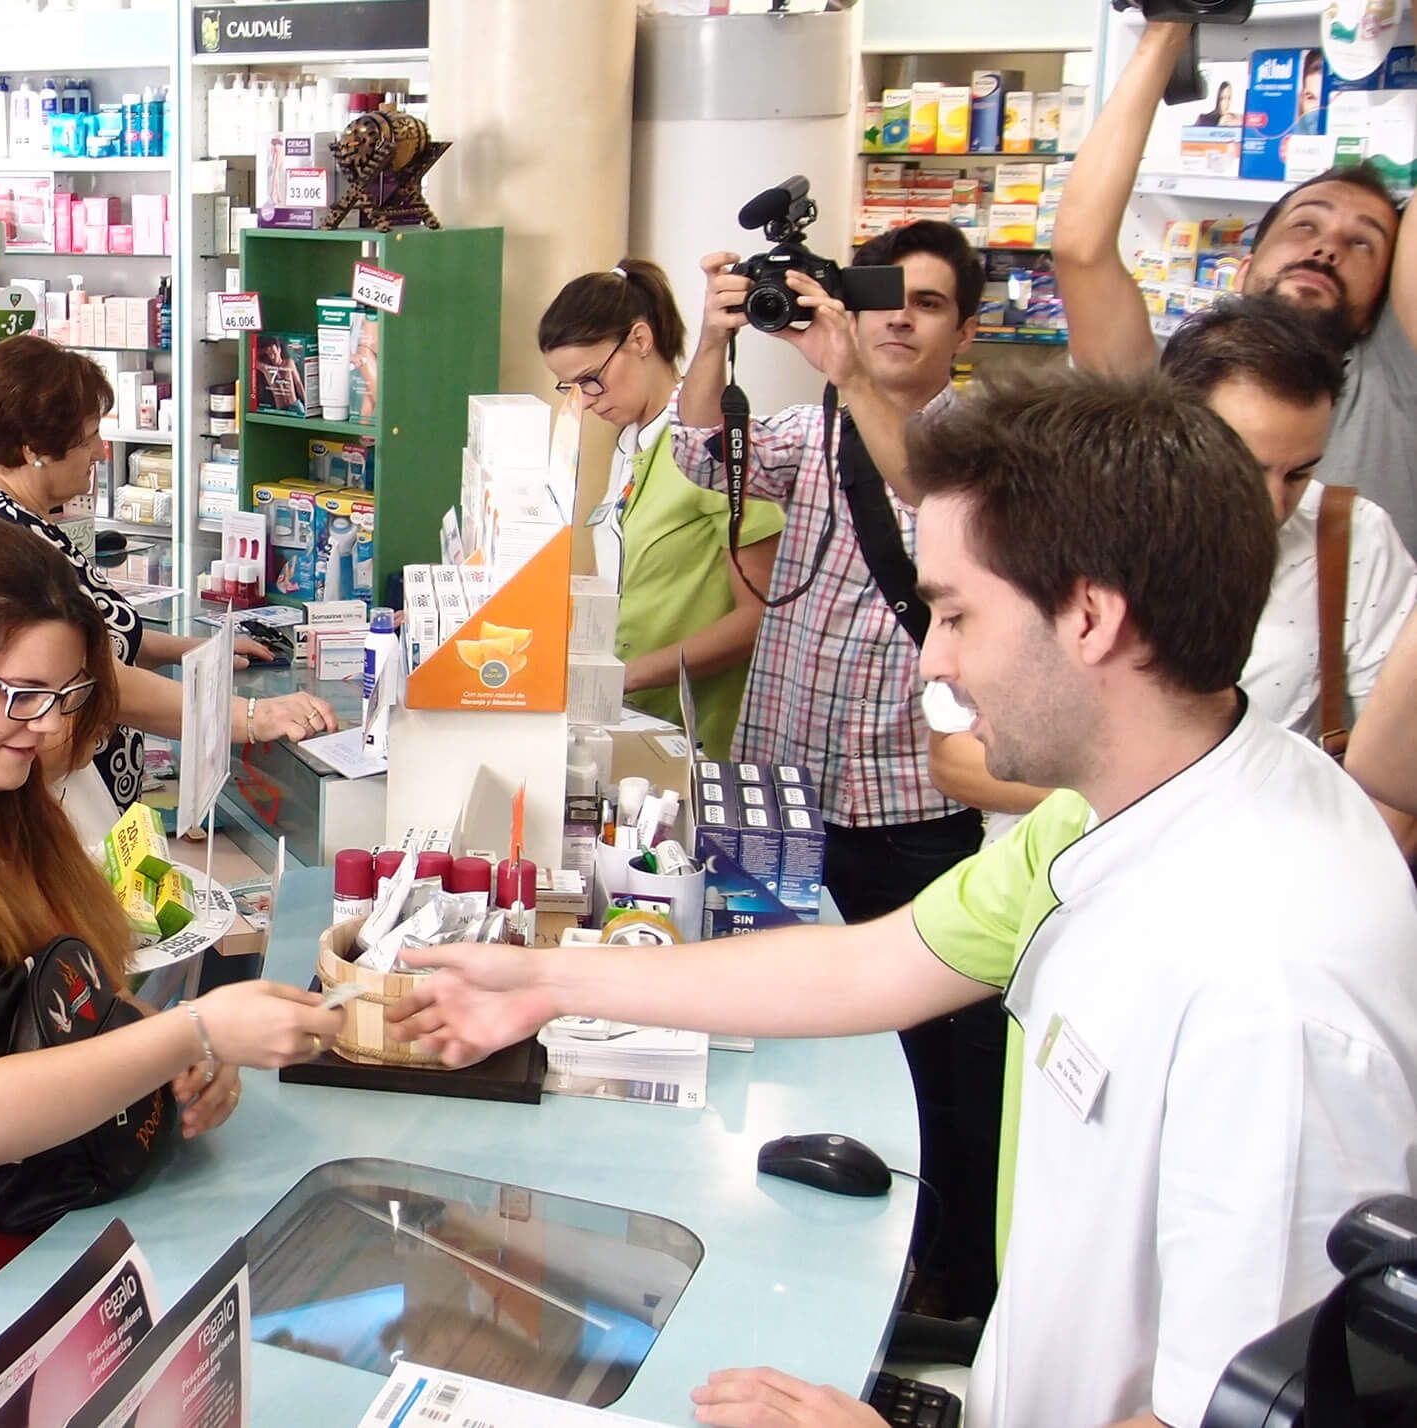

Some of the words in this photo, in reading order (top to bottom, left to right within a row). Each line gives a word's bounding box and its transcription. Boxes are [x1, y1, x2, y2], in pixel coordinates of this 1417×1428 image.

[290, 187, 322, 199] 33.00€
[357, 285, 395, 308] 43.20€
[225, 315, 256, 328] 46.00€
[268, 369, 279, 385] 7
[731, 427, 743, 460] EOS
[117, 829, 132, 867] GRATIS
[733, 914, 754, 926] SIN
[98, 1274, 138, 1326] regalo
[198, 1299, 235, 1352] regalo
[86, 1331, 118, 1364] Práctica
